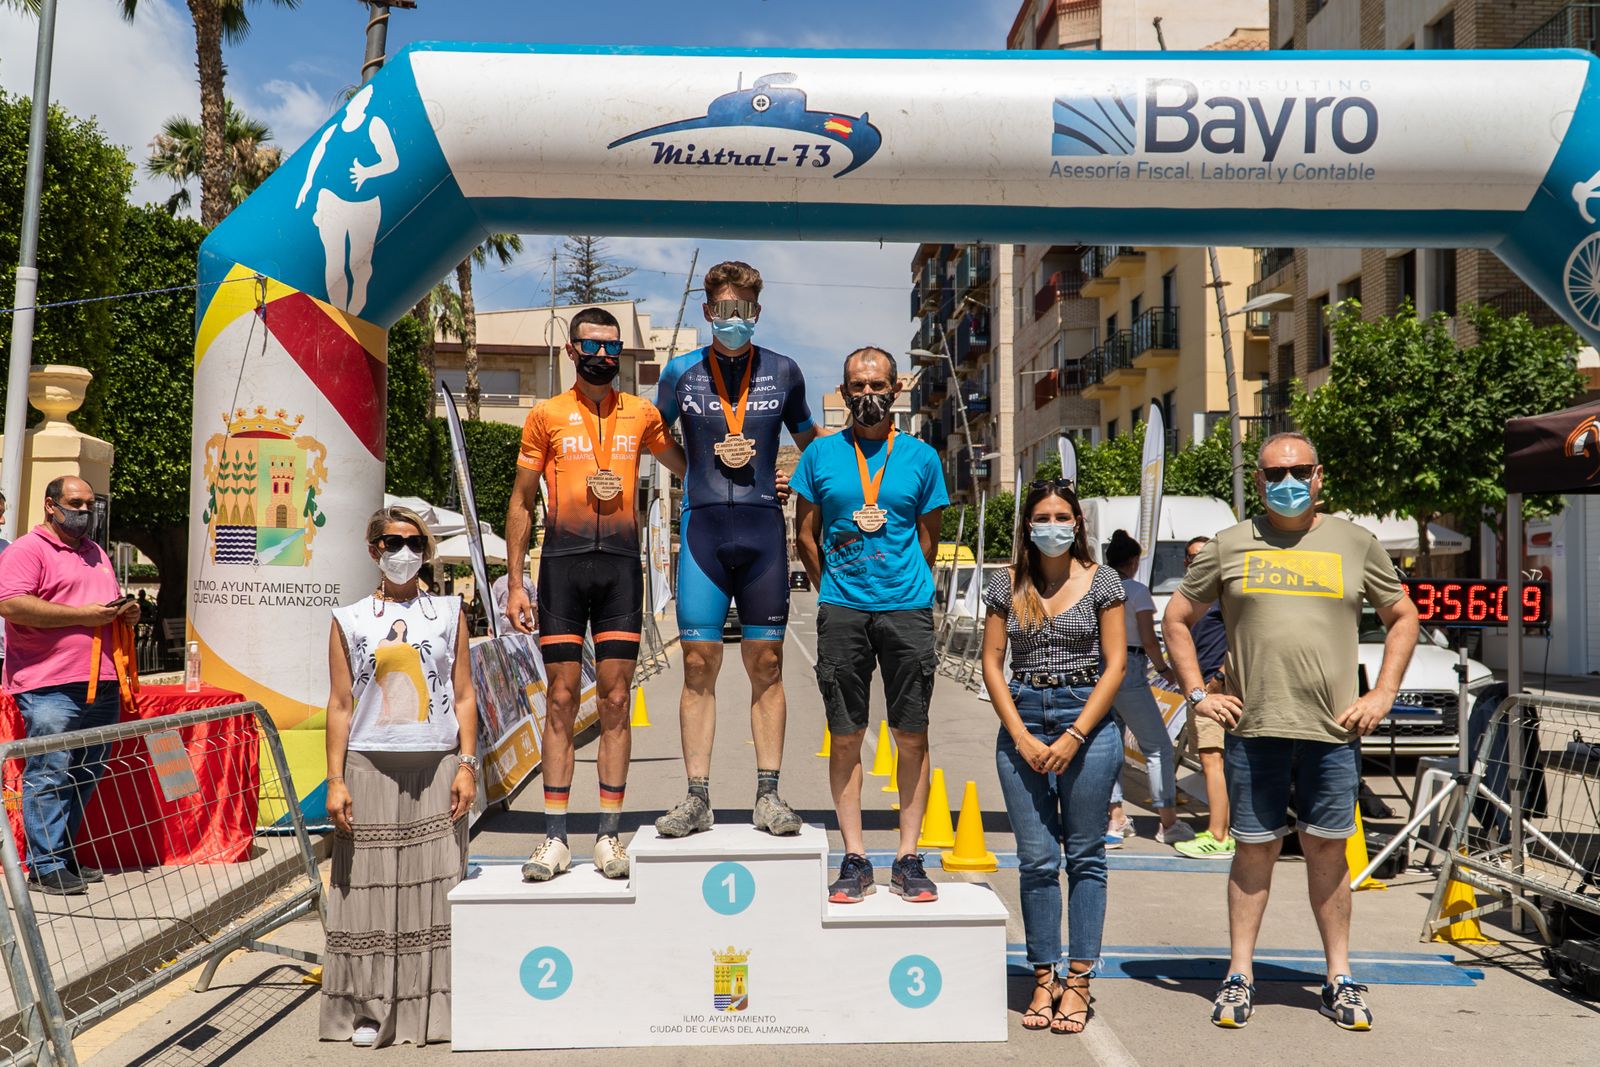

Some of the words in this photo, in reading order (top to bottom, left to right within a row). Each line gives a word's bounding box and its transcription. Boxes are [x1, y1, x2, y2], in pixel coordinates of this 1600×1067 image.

[1201, 79, 1372, 93] CONSULTING
[1144, 78, 1379, 162] Bayro
[650, 141, 832, 168] Mistral-73
[1049, 159, 1130, 180] Asesoría
[1201, 161, 1273, 181] Laboral
[1276, 166, 1287, 185] y
[1293, 161, 1376, 182] Contable
[221, 581, 321, 594] AYUNTAMIENTO
[324, 583, 341, 595] DE
[1256, 572, 1329, 587] JONES
[193, 592, 229, 605] CUEVAS
[231, 594, 255, 605] DEL
[259, 595, 340, 607] ALMANZORA
[720, 872, 737, 904] 1
[538, 958, 557, 989] 2
[906, 966, 926, 997] 3
[682, 1015, 706, 1023] ILMO.
[708, 1015, 777, 1023] AYUNTAMIENTO
[650, 1025, 683, 1033] CIUDAD
[686, 1025, 698, 1033] DE
[700, 1025, 735, 1034] CUEVAS
[737, 1025, 754, 1034] DEL
[755, 1026, 810, 1034] ALMANZORA
